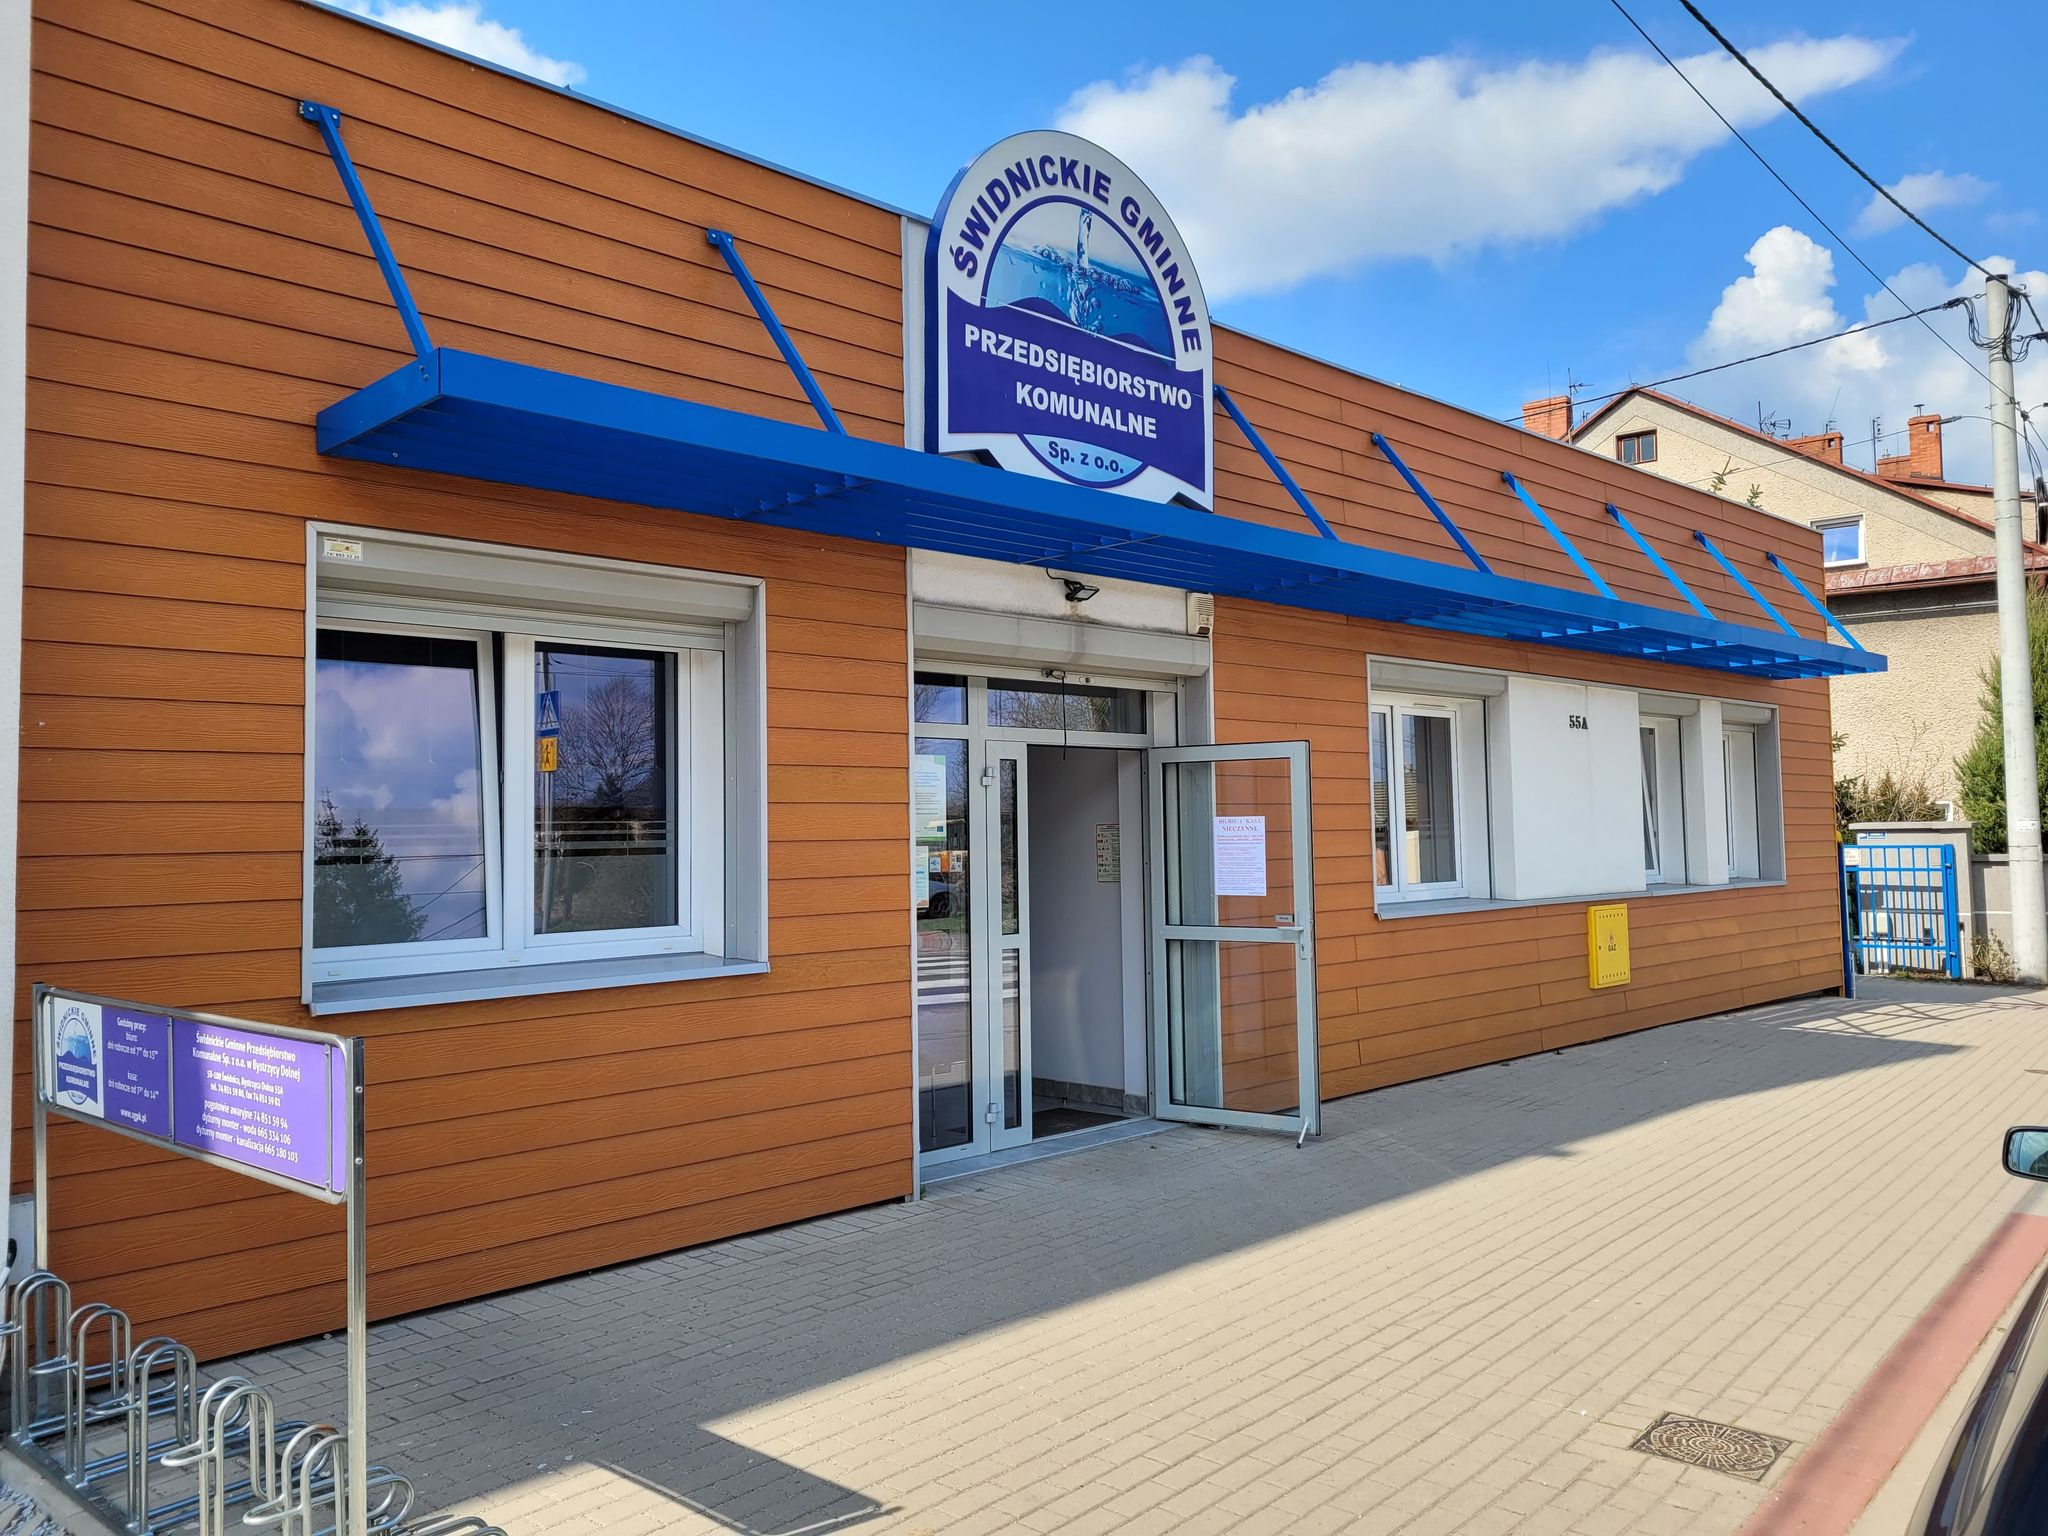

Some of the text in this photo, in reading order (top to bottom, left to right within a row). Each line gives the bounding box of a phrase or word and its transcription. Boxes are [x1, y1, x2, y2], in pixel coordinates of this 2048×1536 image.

[950, 155, 1202, 352] ŚWIDNICKIE GMINNE
[965, 324, 1192, 410] PRZEDSIĘBIORSTWO
[1016, 382, 1157, 439] KOMUNALNE
[1048, 440, 1124, 474] Sp. z o.o.
[1569, 714, 1589, 730] 55A
[1608, 944, 1616, 952] GAZ
[224, 1037, 246, 1053] Gminne
[246, 1042, 296, 1062] Przedsiębiorstwo
[193, 1046, 222, 1063] Komunalne
[221, 1052, 231, 1067] Sp.
[252, 1058, 280, 1079] Bystrzycy
[280, 1064, 301, 1083] Dolnej
[253, 1110, 261, 1123] 74
[260, 1111, 272, 1125] 851
[271, 1115, 280, 1128] 59
[280, 1117, 288, 1131] 94
[257, 1126, 269, 1140] 665
[268, 1129, 280, 1143] 334
[280, 1133, 291, 1146] 106
[264, 1142, 276, 1157] 665
[287, 1150, 299, 1163] 103
